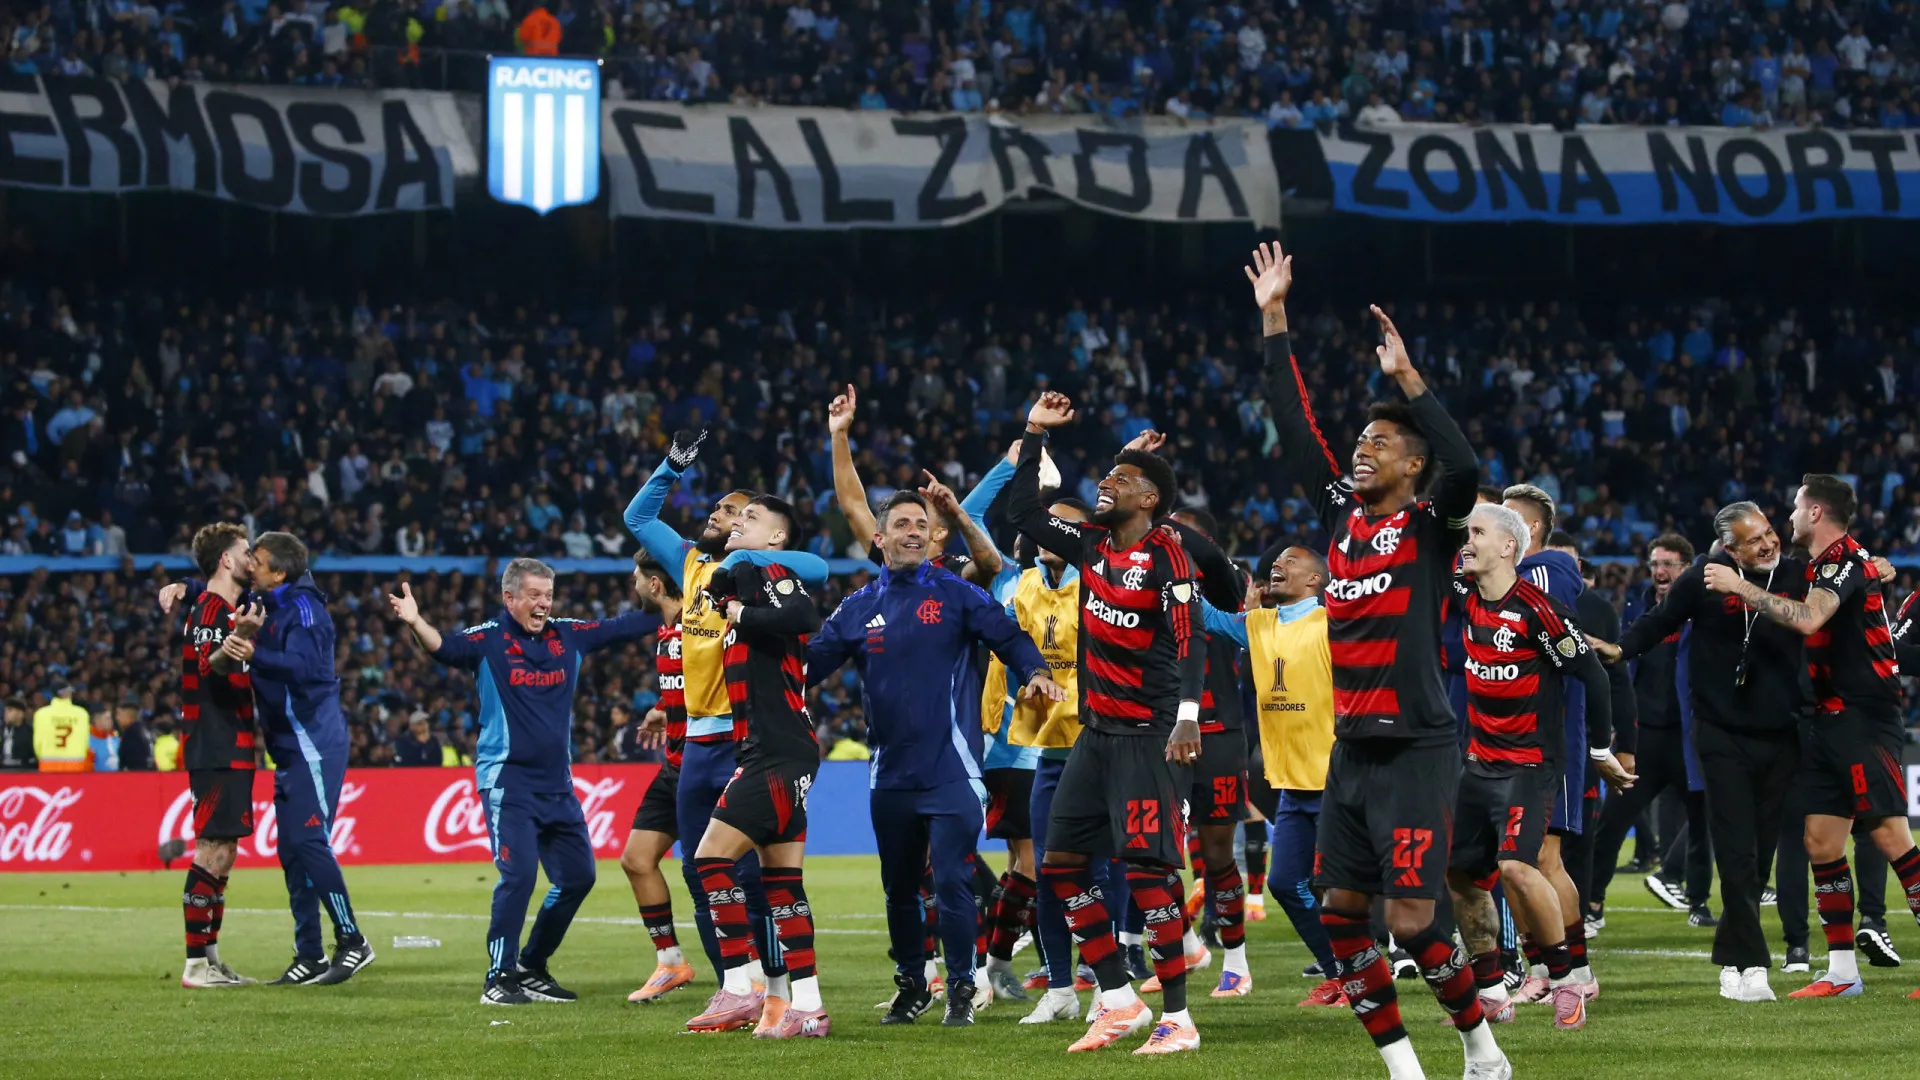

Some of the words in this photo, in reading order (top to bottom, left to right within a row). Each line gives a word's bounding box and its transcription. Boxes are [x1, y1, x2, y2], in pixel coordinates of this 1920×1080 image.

[496, 65, 593, 90] RACING
[612, 108, 1249, 223] CALZADA
[1337, 123, 1621, 216] ZONA
[1647, 129, 1920, 217] NORT
[1834, 561, 1854, 588] Shopee
[1085, 590, 1140, 628] Betano
[1563, 618, 1590, 655] Shopee
[1893, 619, 1913, 640] hopee
[1538, 631, 1563, 668] Shopee
[509, 668, 566, 686] Betano
[1261, 703, 1306, 712] LIBERTADORES
[55, 725, 73, 748] 3
[1213, 775, 1237, 805] 52
[1851, 763, 1868, 794] 8
[0, 786, 85, 862] ola
[1126, 799, 1159, 834] 22
[1505, 806, 1525, 836] 2
[1393, 828, 1433, 868] 27
[1065, 892, 1092, 908] Zé
[1144, 907, 1170, 921] Zé
